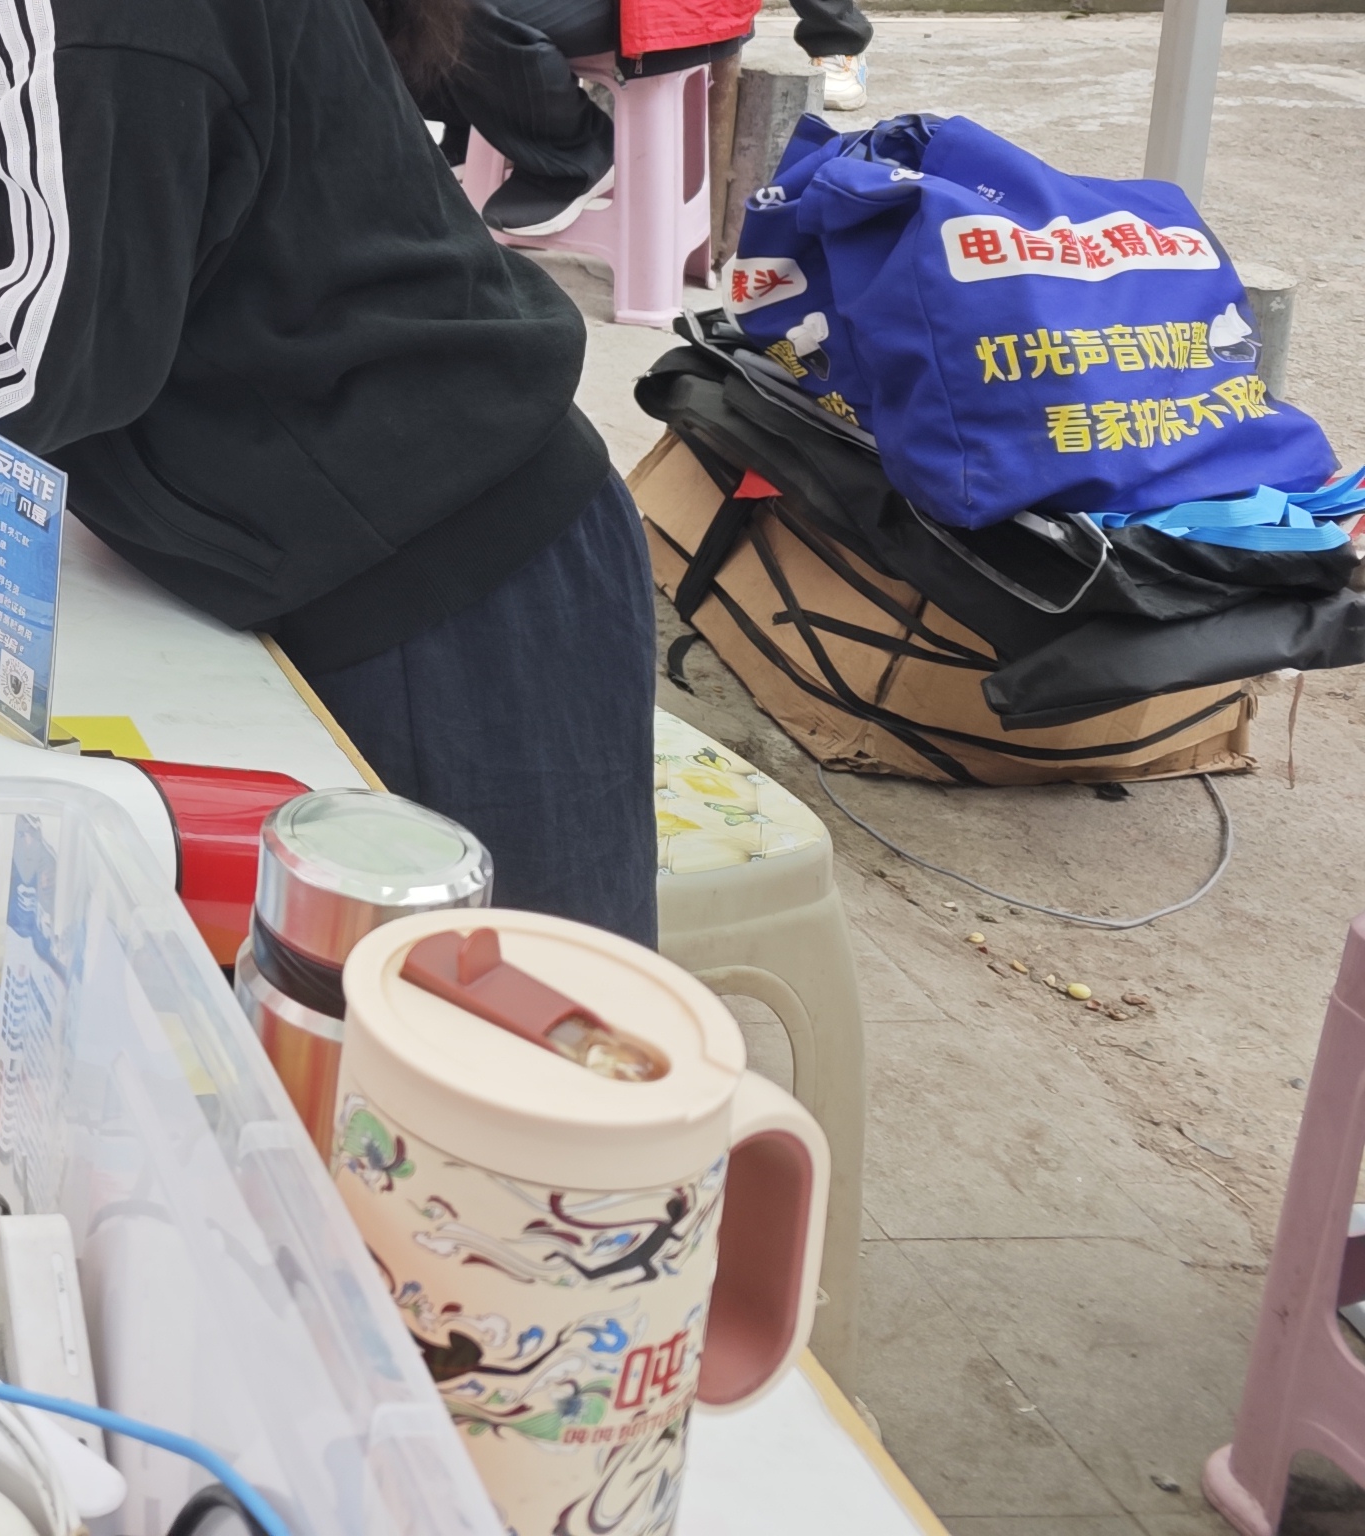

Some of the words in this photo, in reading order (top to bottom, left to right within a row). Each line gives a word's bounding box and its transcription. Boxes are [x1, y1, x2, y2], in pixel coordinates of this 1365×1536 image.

[959, 223, 1210, 270] 电信智能摄像头
[976, 321, 1215, 385] 灯光声音双报警
